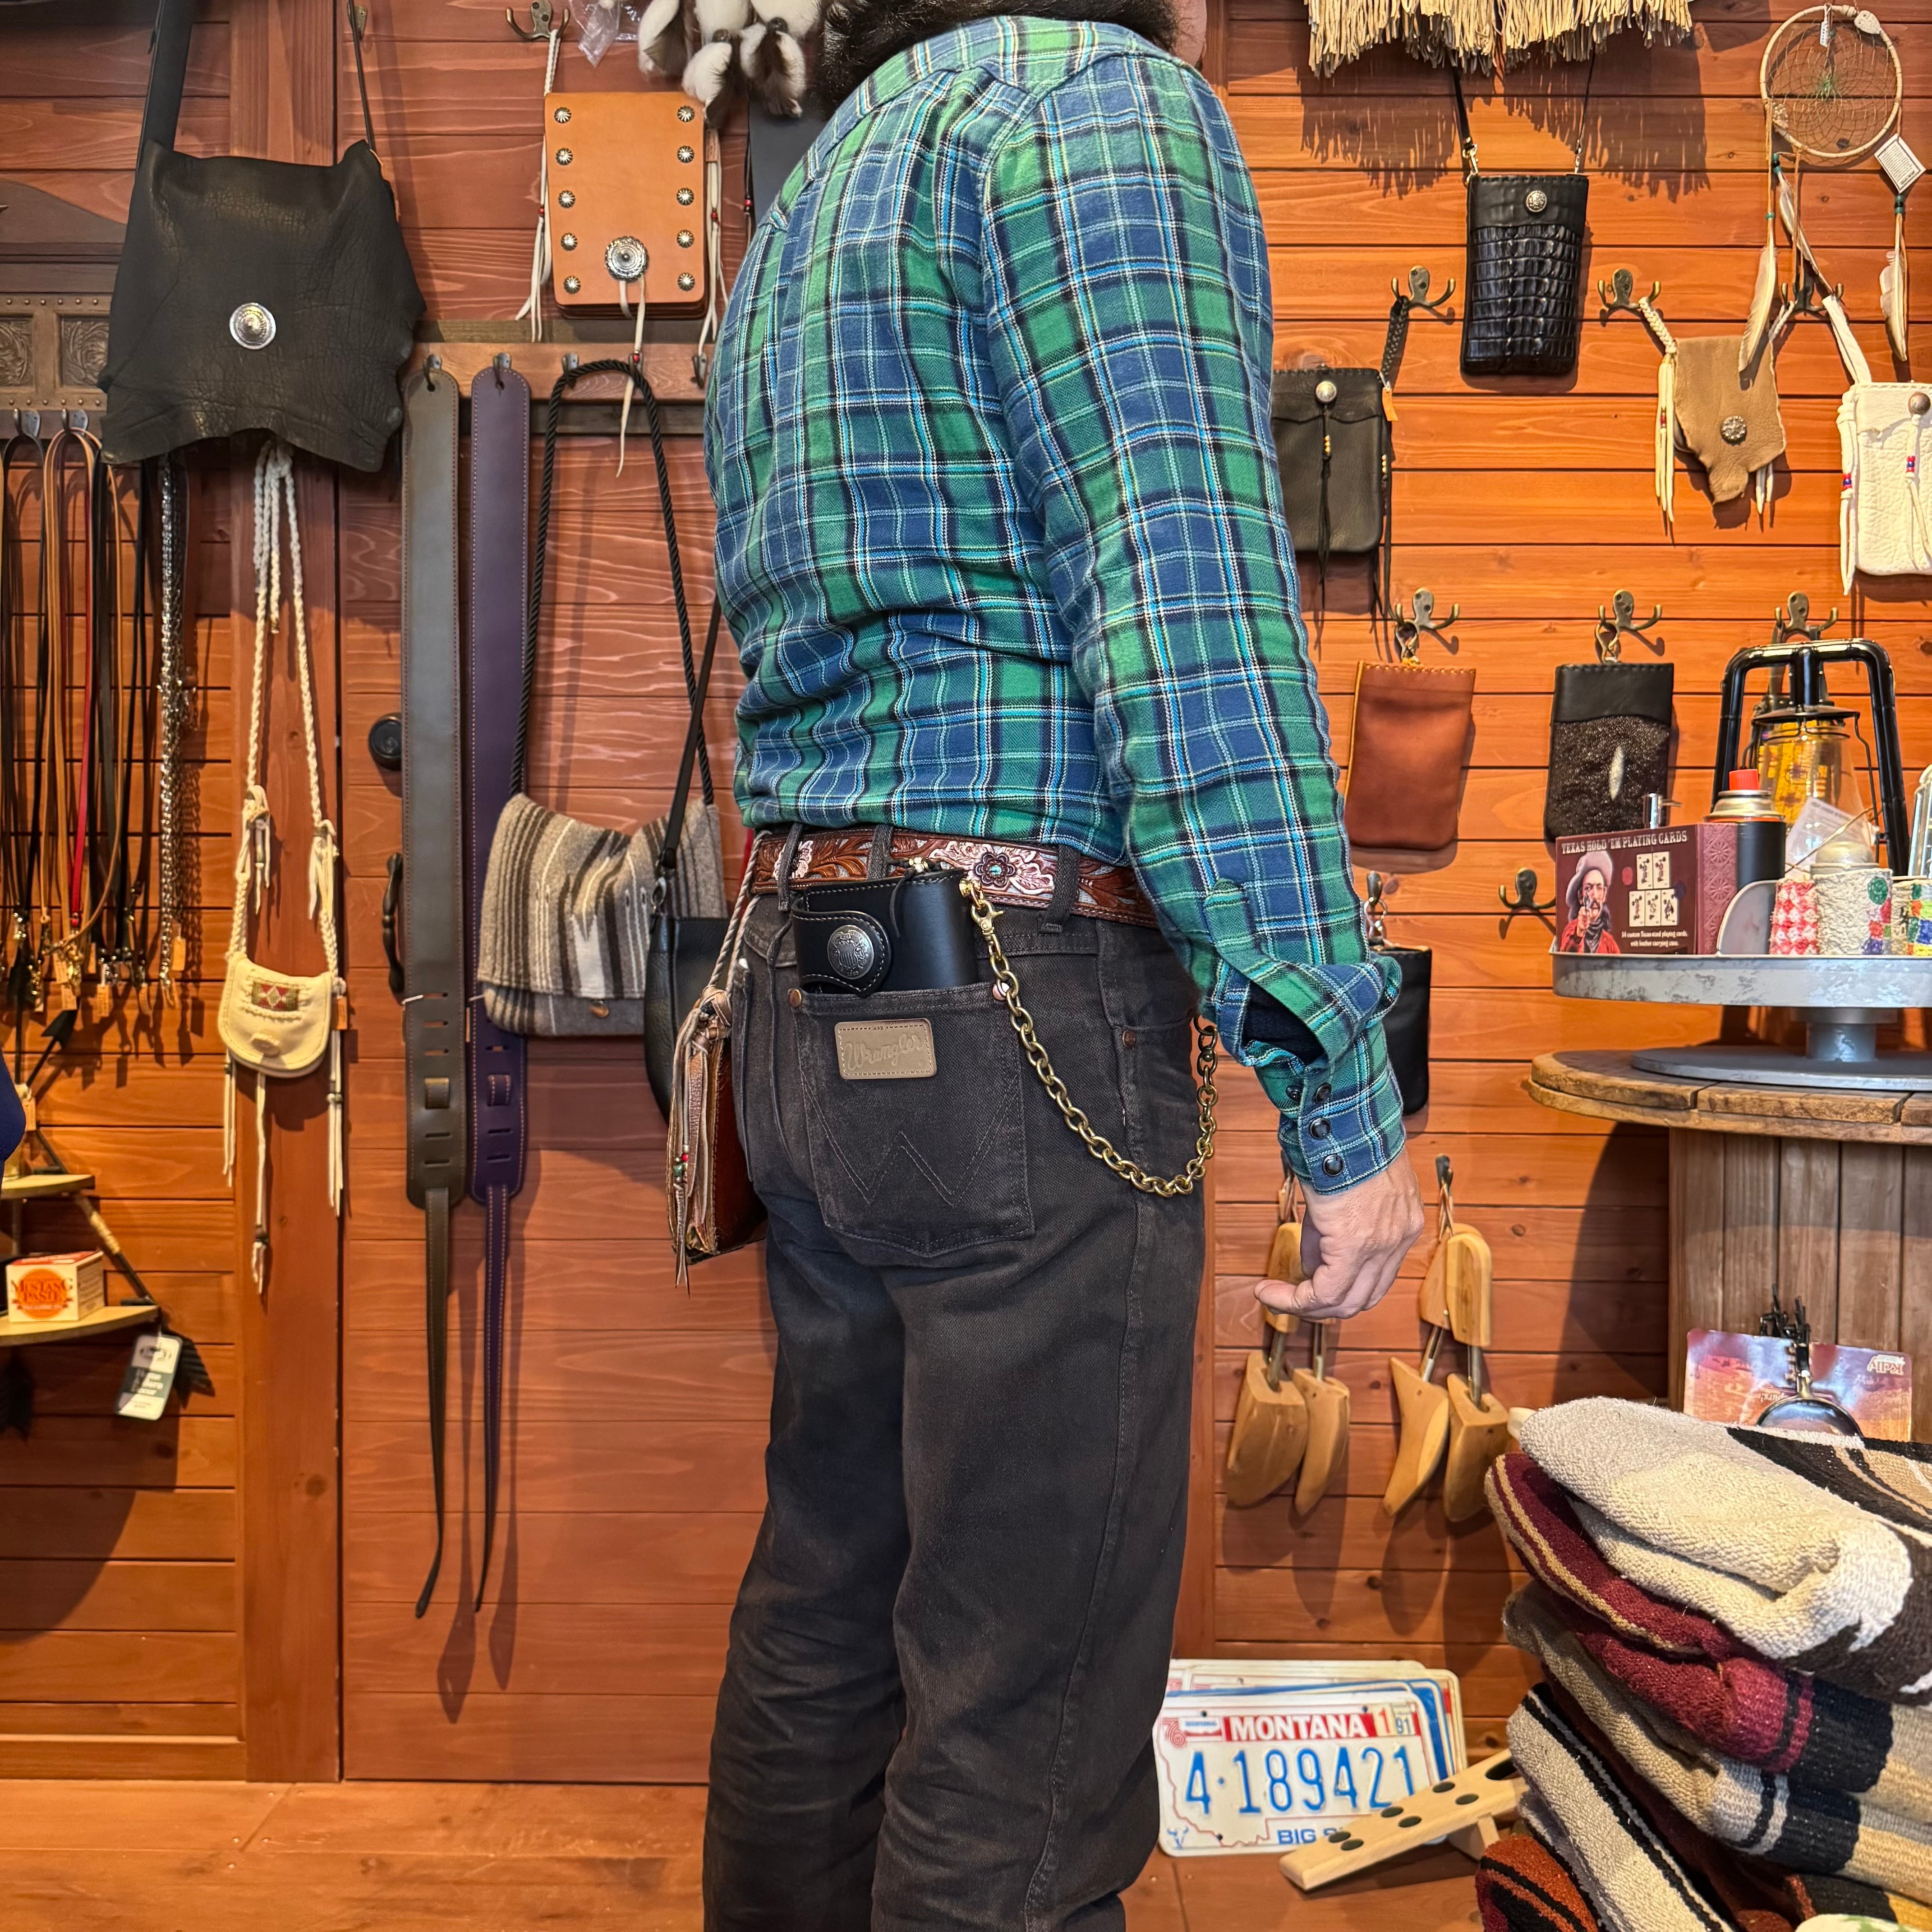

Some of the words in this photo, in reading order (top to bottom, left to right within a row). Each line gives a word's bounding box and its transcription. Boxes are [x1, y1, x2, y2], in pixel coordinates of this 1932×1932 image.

[1561, 842, 1585, 854] TEXAS
[1587, 839, 1606, 852] HOLD
[1623, 834, 1656, 848] PLAYING
[1658, 830, 1687, 844] CARDS
[845, 1033, 925, 1071] Wrangler
[1231, 1714, 1369, 1741] MONTANA
[1396, 1717, 1411, 1736] 91
[1277, 1828, 1316, 1845] BIG
